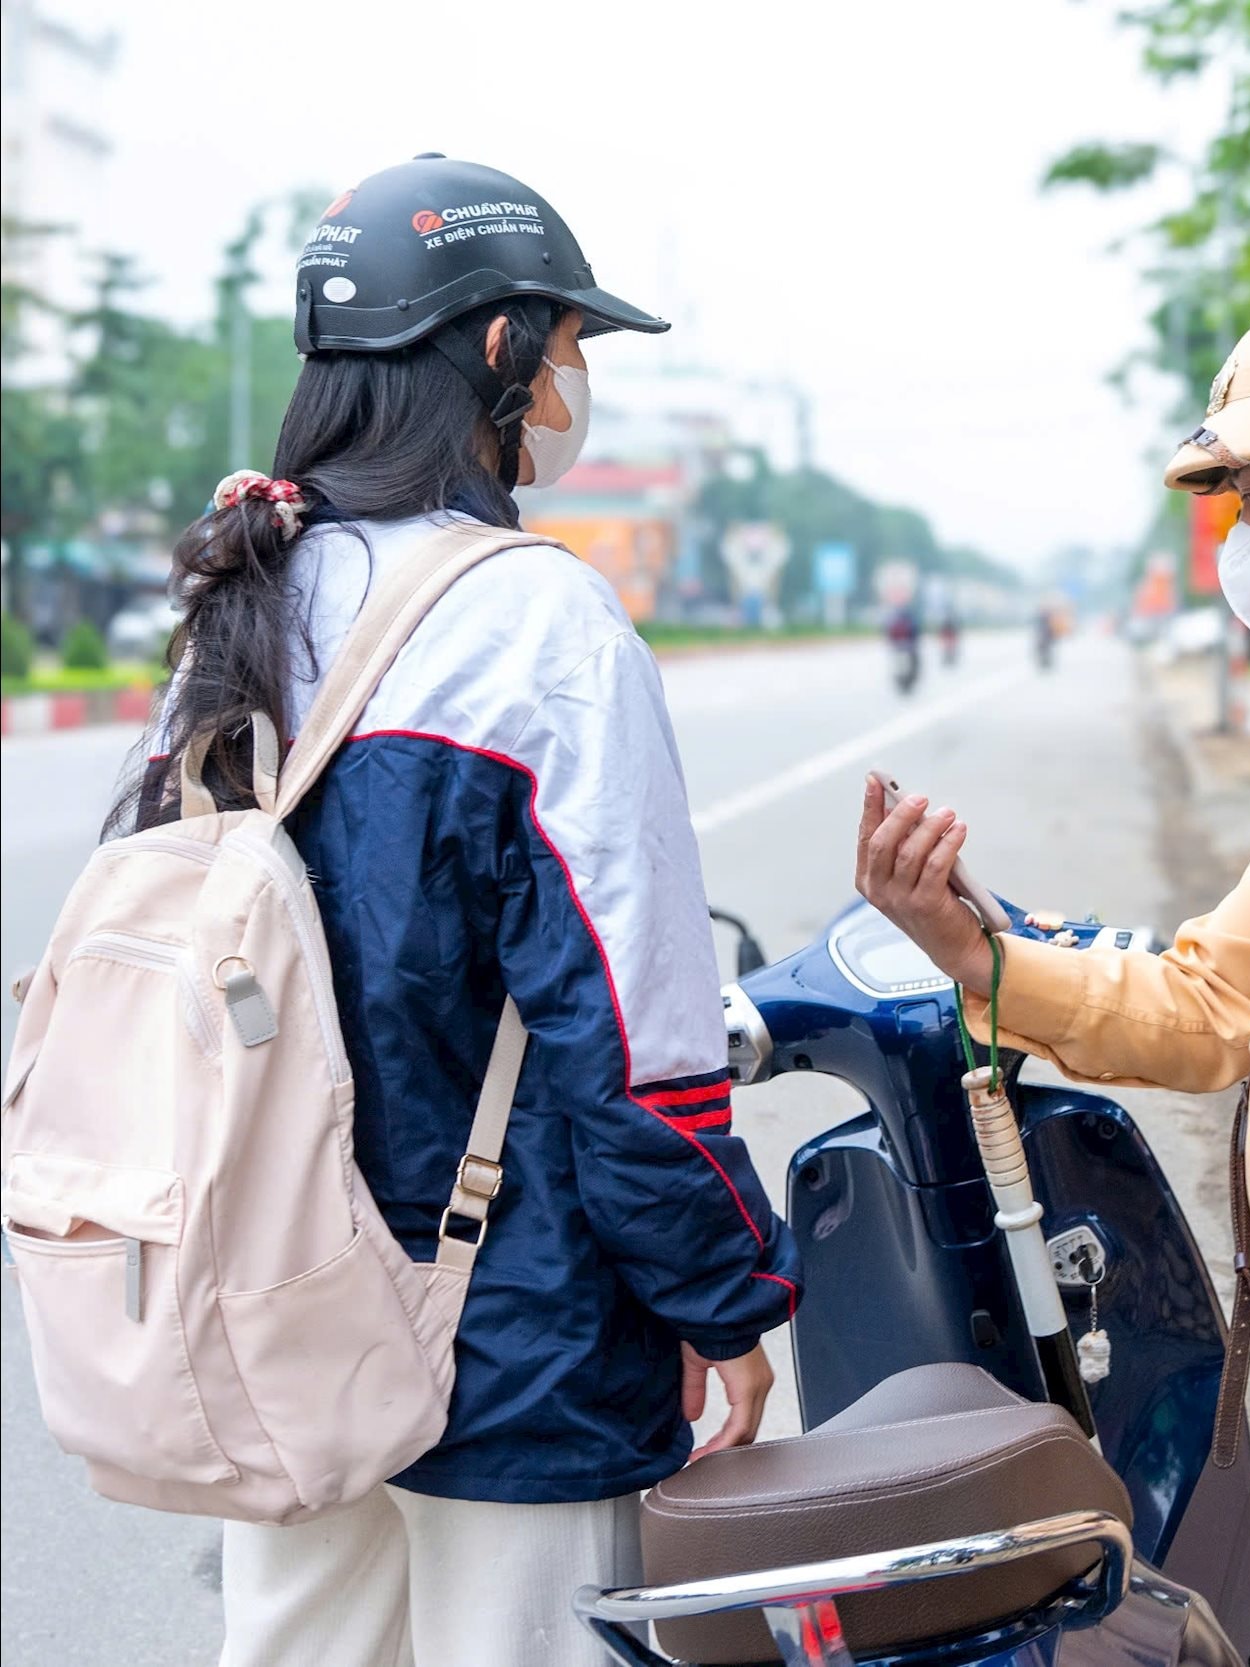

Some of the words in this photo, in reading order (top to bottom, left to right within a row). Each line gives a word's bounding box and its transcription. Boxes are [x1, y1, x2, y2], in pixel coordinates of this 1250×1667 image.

[500, 201, 539, 217] PHÁT
[424, 236, 444, 250] XE
[444, 226, 476, 241] ĐIỆN
[477, 219, 517, 236] CHUẨN
[519, 223, 545, 236] PHÁT
